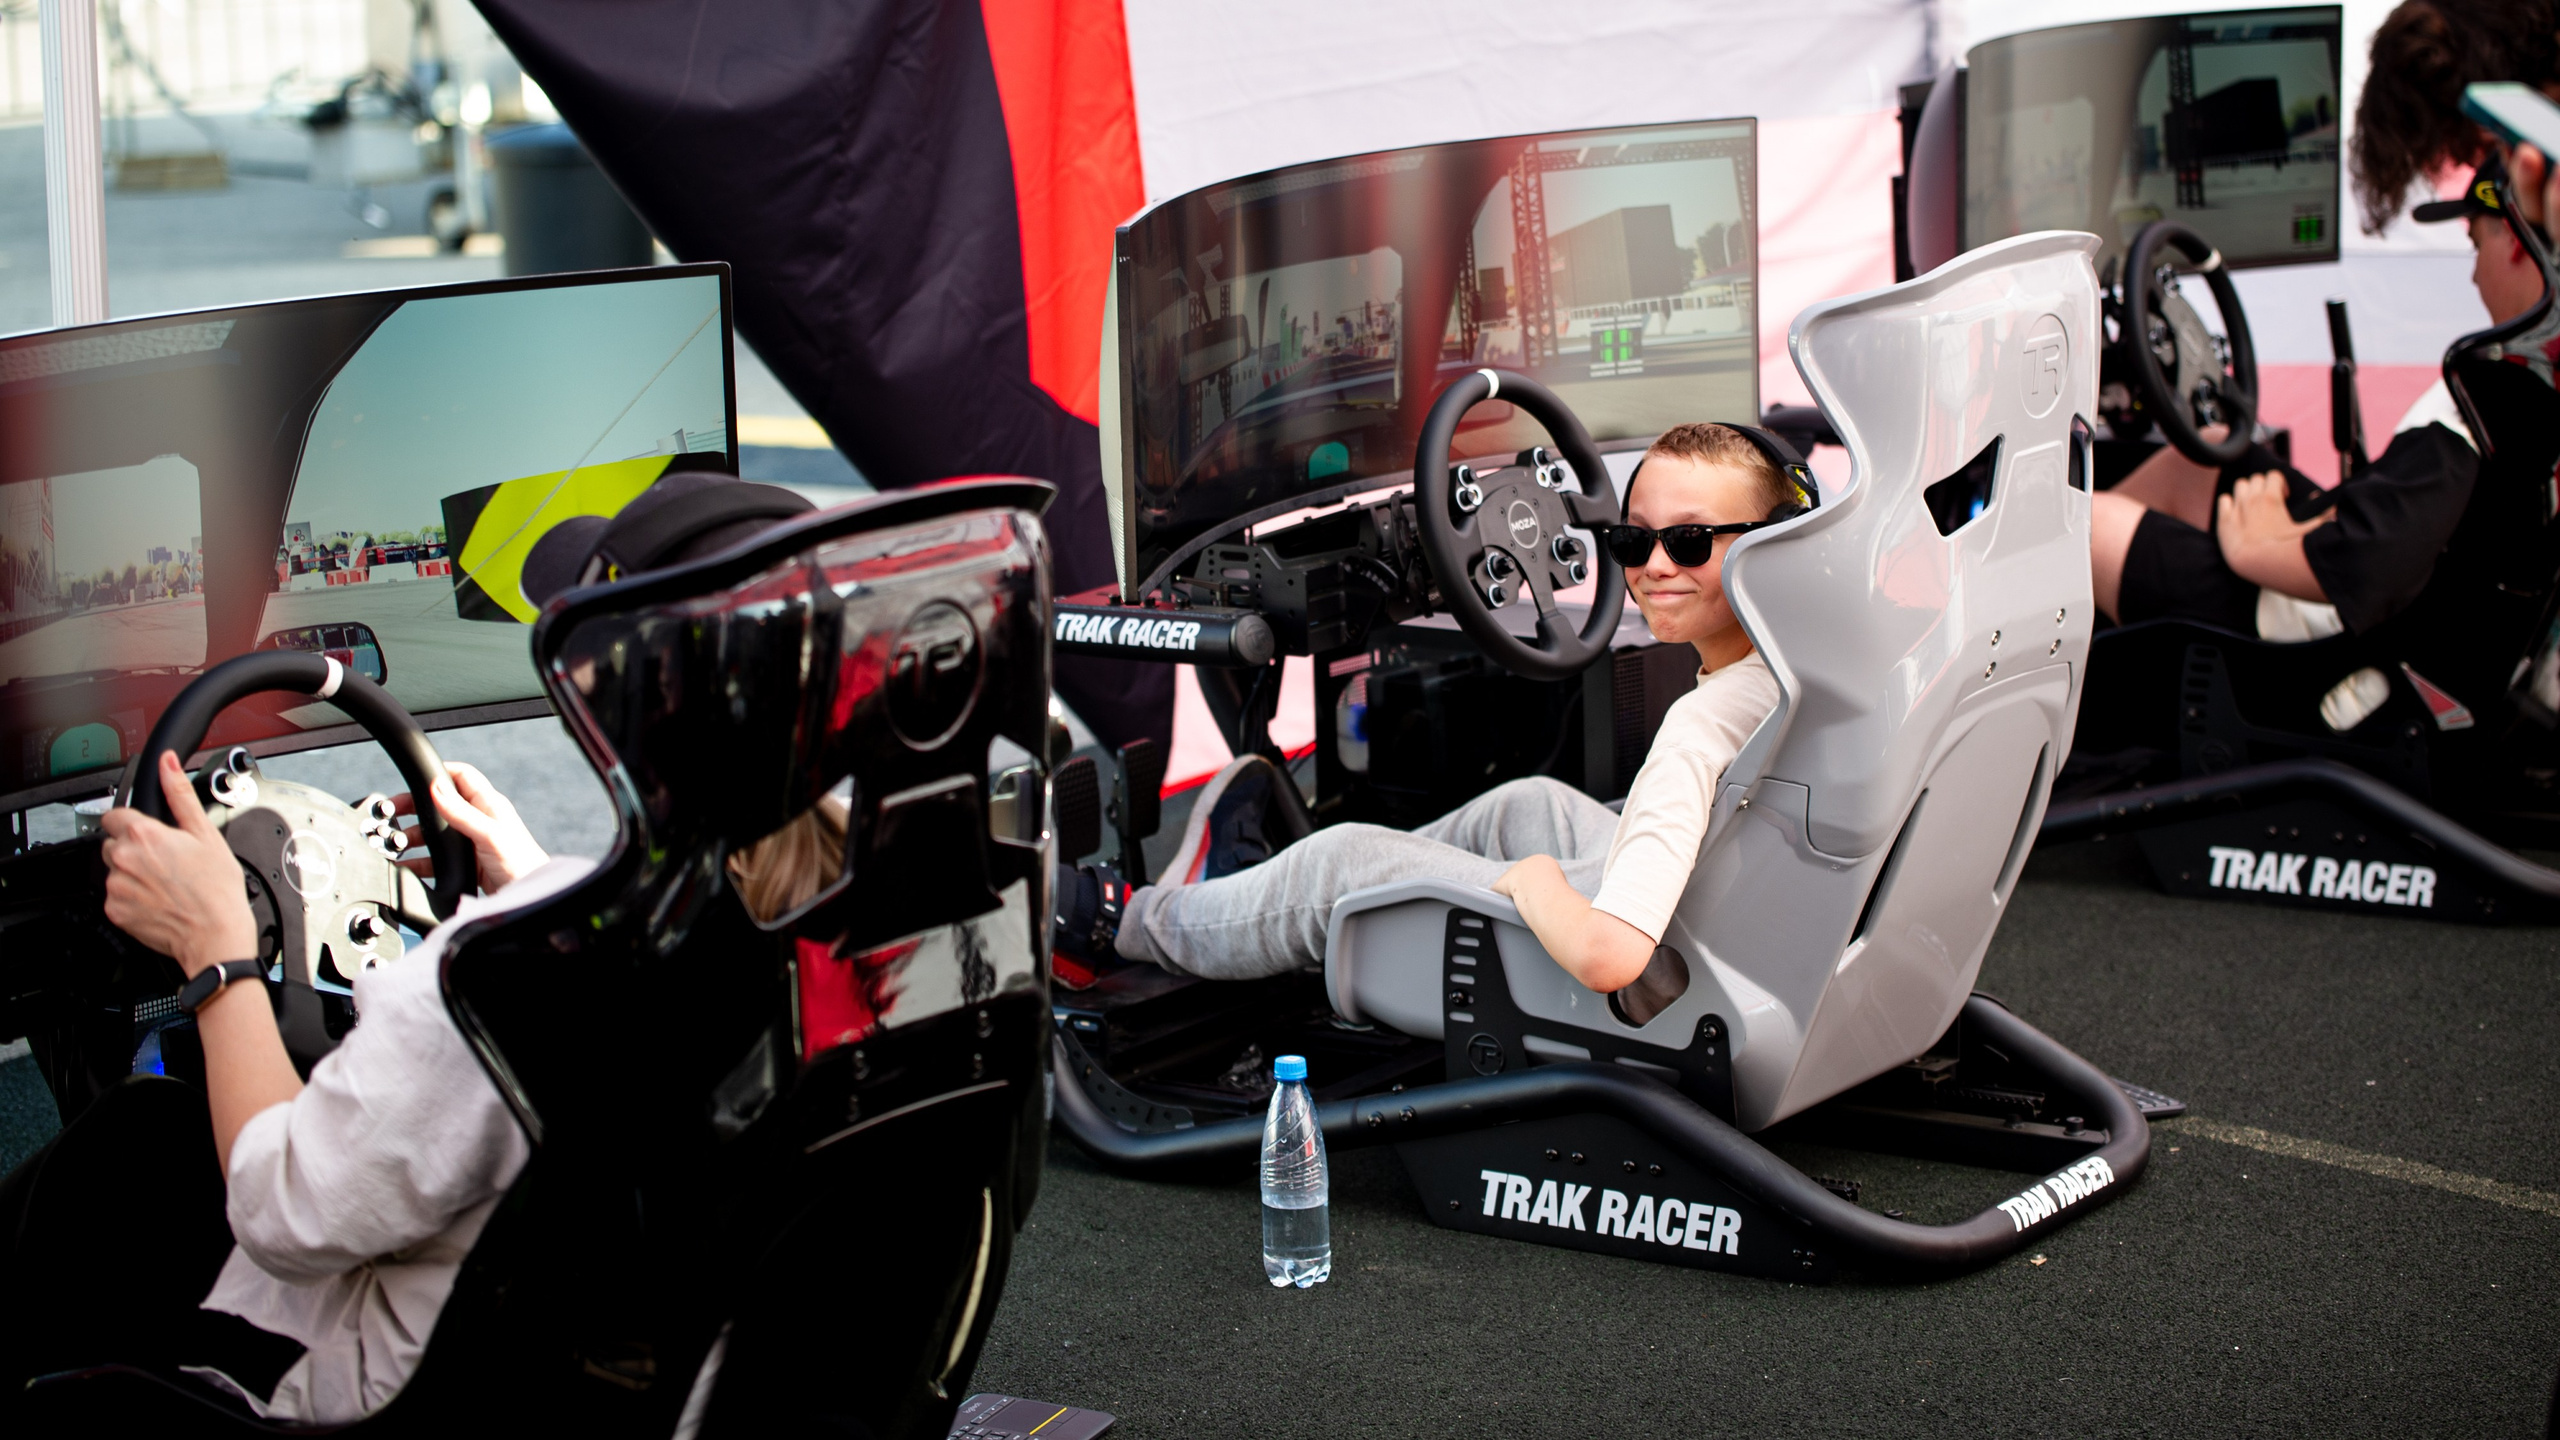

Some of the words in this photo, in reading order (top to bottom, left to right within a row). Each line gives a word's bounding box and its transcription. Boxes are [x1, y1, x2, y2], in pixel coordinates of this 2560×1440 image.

[1510, 516, 1537, 533] MOZA
[1056, 612, 1120, 645] TRAK
[1118, 617, 1201, 651] RACER
[2209, 846, 2307, 895] TRAK
[2309, 857, 2436, 907] RACER
[1481, 1170, 1592, 1232] TRAK
[1597, 1189, 1742, 1256] RACER
[1997, 1184, 2059, 1233] TRAK
[2044, 1156, 2115, 1210] RACER
